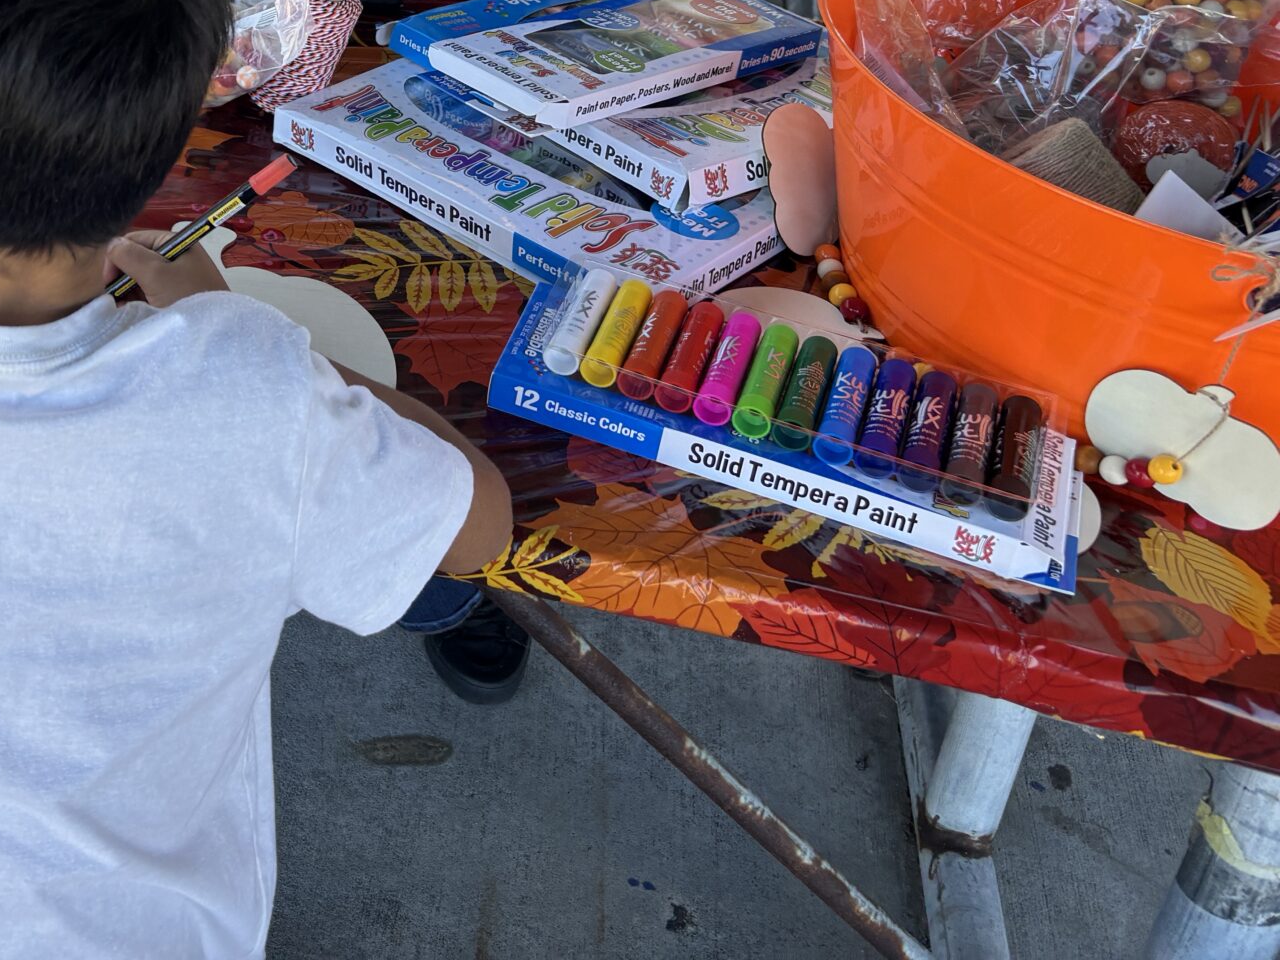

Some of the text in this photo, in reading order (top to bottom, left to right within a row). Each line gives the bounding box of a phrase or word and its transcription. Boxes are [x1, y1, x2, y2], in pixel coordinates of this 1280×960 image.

[399, 33, 424, 55] Dries
[442, 42, 478, 61] Paint
[740, 40, 816, 71] Dries in 90 seconds
[476, 54, 528, 87] Tempera
[599, 53, 632, 73] Mess
[522, 78, 559, 103] Solid
[575, 61, 734, 117] Paint on Paper, Posters, Wood and More!
[311, 84, 417, 142] Paint
[395, 125, 547, 214] Tempera
[604, 146, 644, 179] Paint
[746, 156, 771, 181] Sol
[335, 145, 492, 242] Solid Tempera Paint
[523, 193, 658, 253] Solid
[517, 246, 563, 279] Perfect
[708, 248, 753, 288] Tempera
[754, 233, 779, 261] Paint
[524, 307, 556, 358] Washable
[513, 385, 646, 441] 12 Classic Colors
[1043, 432, 1065, 466] Solid
[688, 442, 919, 535] Solid Tempera Paint
[1032, 510, 1057, 551] Paint
